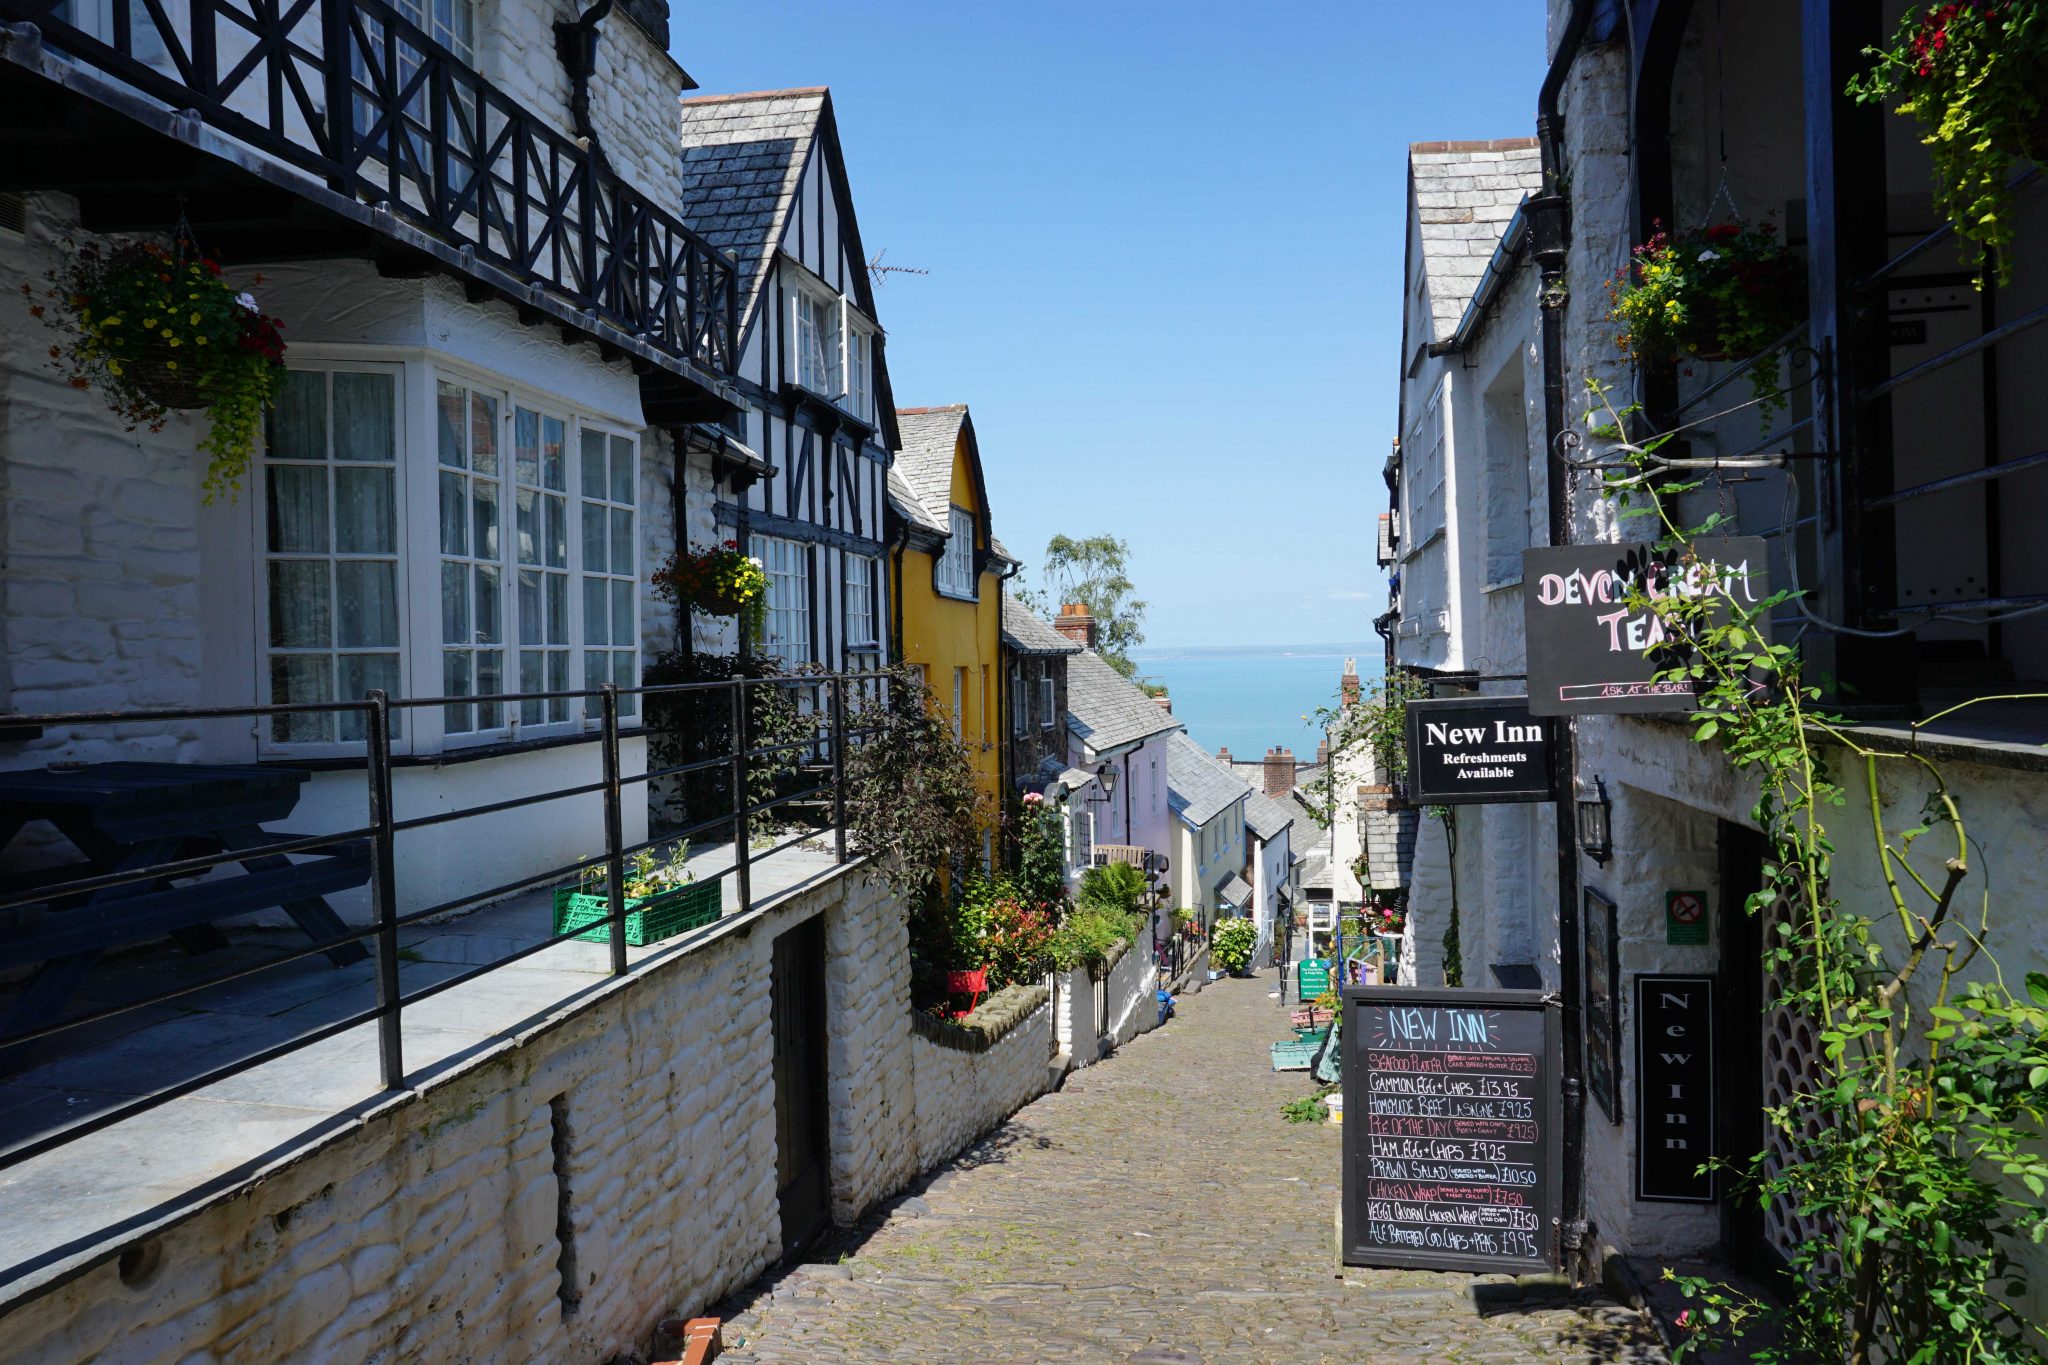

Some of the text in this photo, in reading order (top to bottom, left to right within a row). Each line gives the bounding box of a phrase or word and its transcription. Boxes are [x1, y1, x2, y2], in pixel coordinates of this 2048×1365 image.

[1537, 558, 1759, 606] DEVON CREAM
[1601, 684, 1688, 696] ASK AT THE BAR!
[1425, 720, 1543, 746] New Inn
[1442, 752, 1527, 765] Refreshments
[1456, 766, 1515, 779] Available
[1389, 1008, 1488, 1043] NEW INN
[1368, 1053, 1443, 1072] SEAFOOD PLATTER
[1443, 1075, 1474, 1095] CHIPS
[1477, 1076, 1519, 1097] £13.95
[1368, 1094, 1415, 1115] HOMEMADE
[1418, 1095, 1447, 1117] BEEF
[1447, 1097, 1495, 1118] LASAGNE
[1368, 1114, 1390, 1135] PIE
[1391, 1117, 1406, 1135] OF
[1405, 1117, 1425, 1136] THE
[1430, 1139, 1465, 1161] CHIPS
[1370, 1157, 1448, 1180] PRAWN SALAD
[1369, 1178, 1437, 1200] CHICKEN WRAP
[1366, 1201, 1478, 1224] VEGGI QUORN CHICKEN WRAP
[1368, 1221, 1388, 1244] ALE
[1388, 1223, 1425, 1248] BATTERED
[1443, 1227, 1469, 1250] CHIPS
[1473, 1232, 1498, 1255] PEAS
